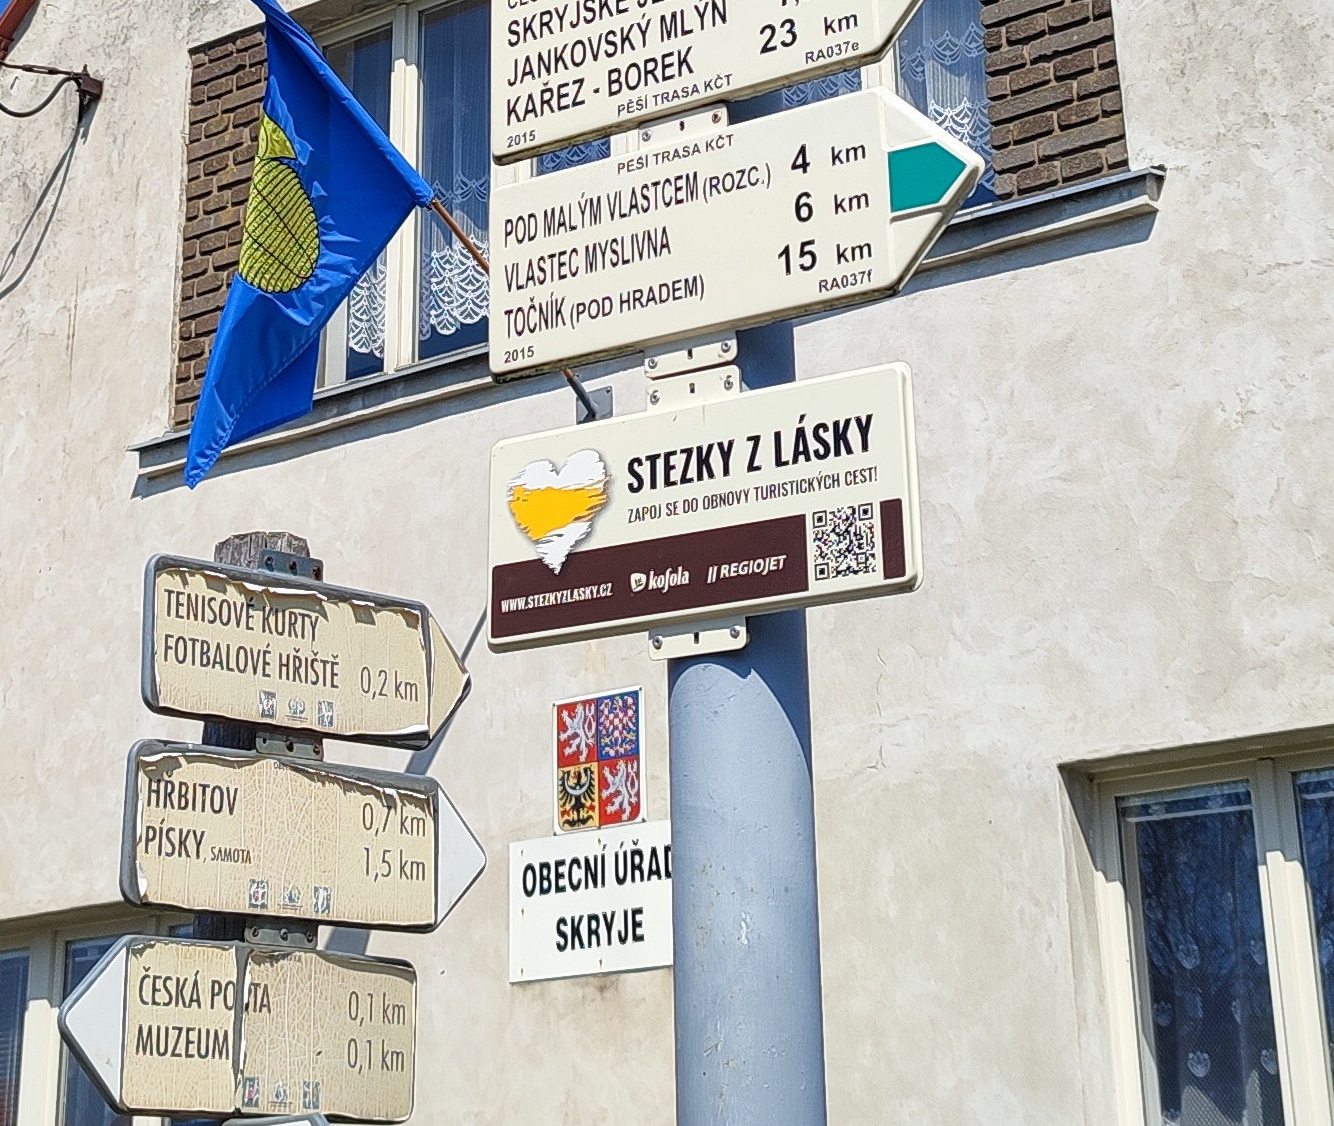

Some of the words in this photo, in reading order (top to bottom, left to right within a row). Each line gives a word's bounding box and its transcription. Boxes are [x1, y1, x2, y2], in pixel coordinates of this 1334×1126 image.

[507, 13, 651, 87] JANKOVSKÝ
[507, 78, 585, 126] KAŘEZ
[608, 46, 694, 97] BOREK
[760, 18, 797, 54] 23
[824, 14, 858, 36] km
[652, 84, 700, 107] TRASA
[507, 130, 535, 148] 2015
[653, 143, 701, 165] TRASA
[505, 213, 537, 248] POD
[544, 192, 601, 238] MALÝM
[607, 171, 698, 221] VLASTCEM
[703, 163, 771, 204] (ROZC.)
[791, 144, 810, 174] 4
[831, 144, 865, 166] km
[505, 248, 579, 292] VLASTEC
[585, 226, 671, 274] MYSLIVNA
[795, 192, 813, 222] 6
[834, 193, 869, 215] km
[504, 292, 566, 338] TOČNÍK
[570, 297, 613, 330] (POD
[620, 274, 704, 314] HRADEM)
[778, 239, 817, 276] 15
[836, 243, 872, 264] km
[505, 346, 534, 363] 2015
[628, 439, 735, 493] STEZKY
[747, 435, 762, 473] Z
[774, 414, 873, 468] LÁSKY
[628, 504, 661, 524] ZAPOJ
[666, 501, 679, 516] SE
[683, 498, 698, 513] DO
[703, 489, 750, 510] OBNOVY
[753, 472, 840, 501] TURISTICKÝCH
[845, 466, 877, 486] CEST!
[164, 589, 255, 631] TENISOVÉ
[262, 606, 319, 642] KURTY
[163, 634, 271, 678] FOTBALOVÉ
[278, 647, 339, 689] HŘIŠTĚ
[360, 665, 389, 699] 0,2
[394, 670, 419, 702] km
[362, 802, 393, 834] 0,7
[399, 806, 426, 838] km
[211, 846, 251, 864] SAMOTA
[363, 848, 391, 882] 1,5
[398, 849, 426, 881] km
[522, 843, 606, 898] OBECNÍ
[556, 906, 645, 952] SKRYJE
[138, 967, 202, 1009] ČESKÁ
[211, 978, 271, 1014] POTA
[348, 990, 375, 1026] 0,1
[382, 993, 406, 1026] km
[135, 1024, 230, 1061] MUZEUM
[347, 1037, 374, 1073] 0,1
[381, 1039, 405, 1073] km
